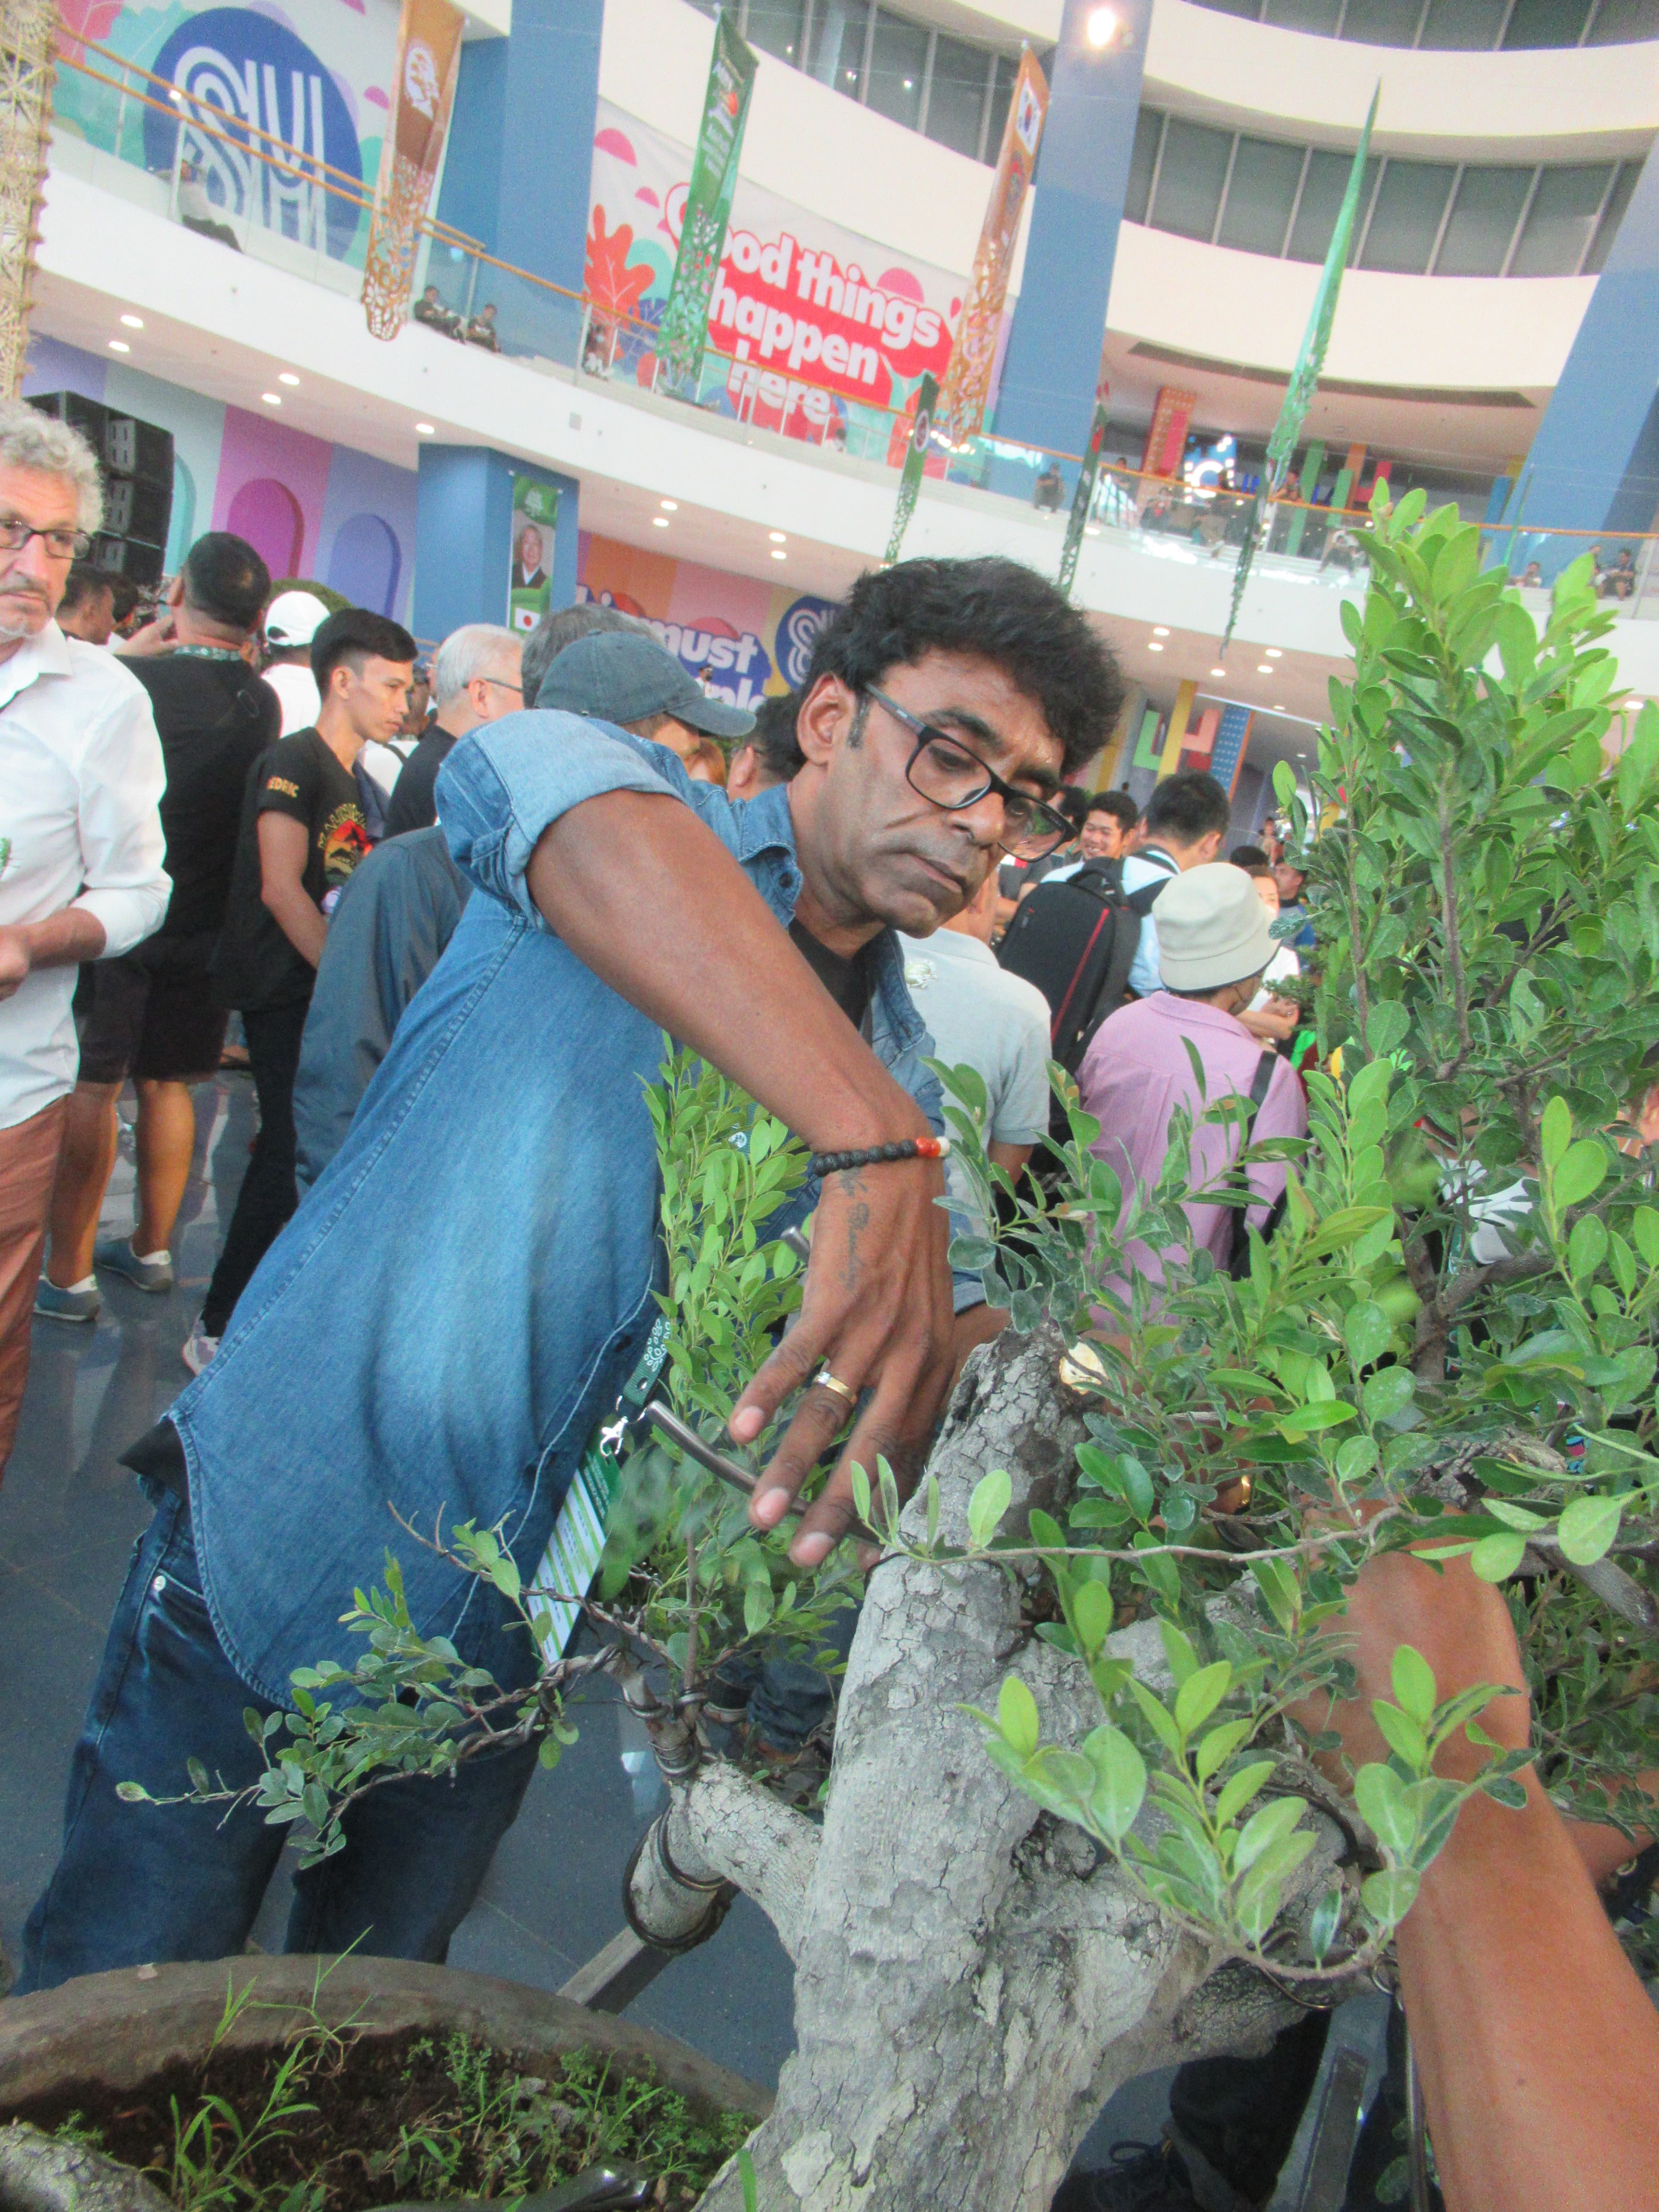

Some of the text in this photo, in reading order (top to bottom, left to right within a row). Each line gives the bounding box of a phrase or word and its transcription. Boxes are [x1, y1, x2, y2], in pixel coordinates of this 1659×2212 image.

[708, 267, 879, 385] happen
[796, 252, 941, 351] things
[728, 338, 831, 425] here
